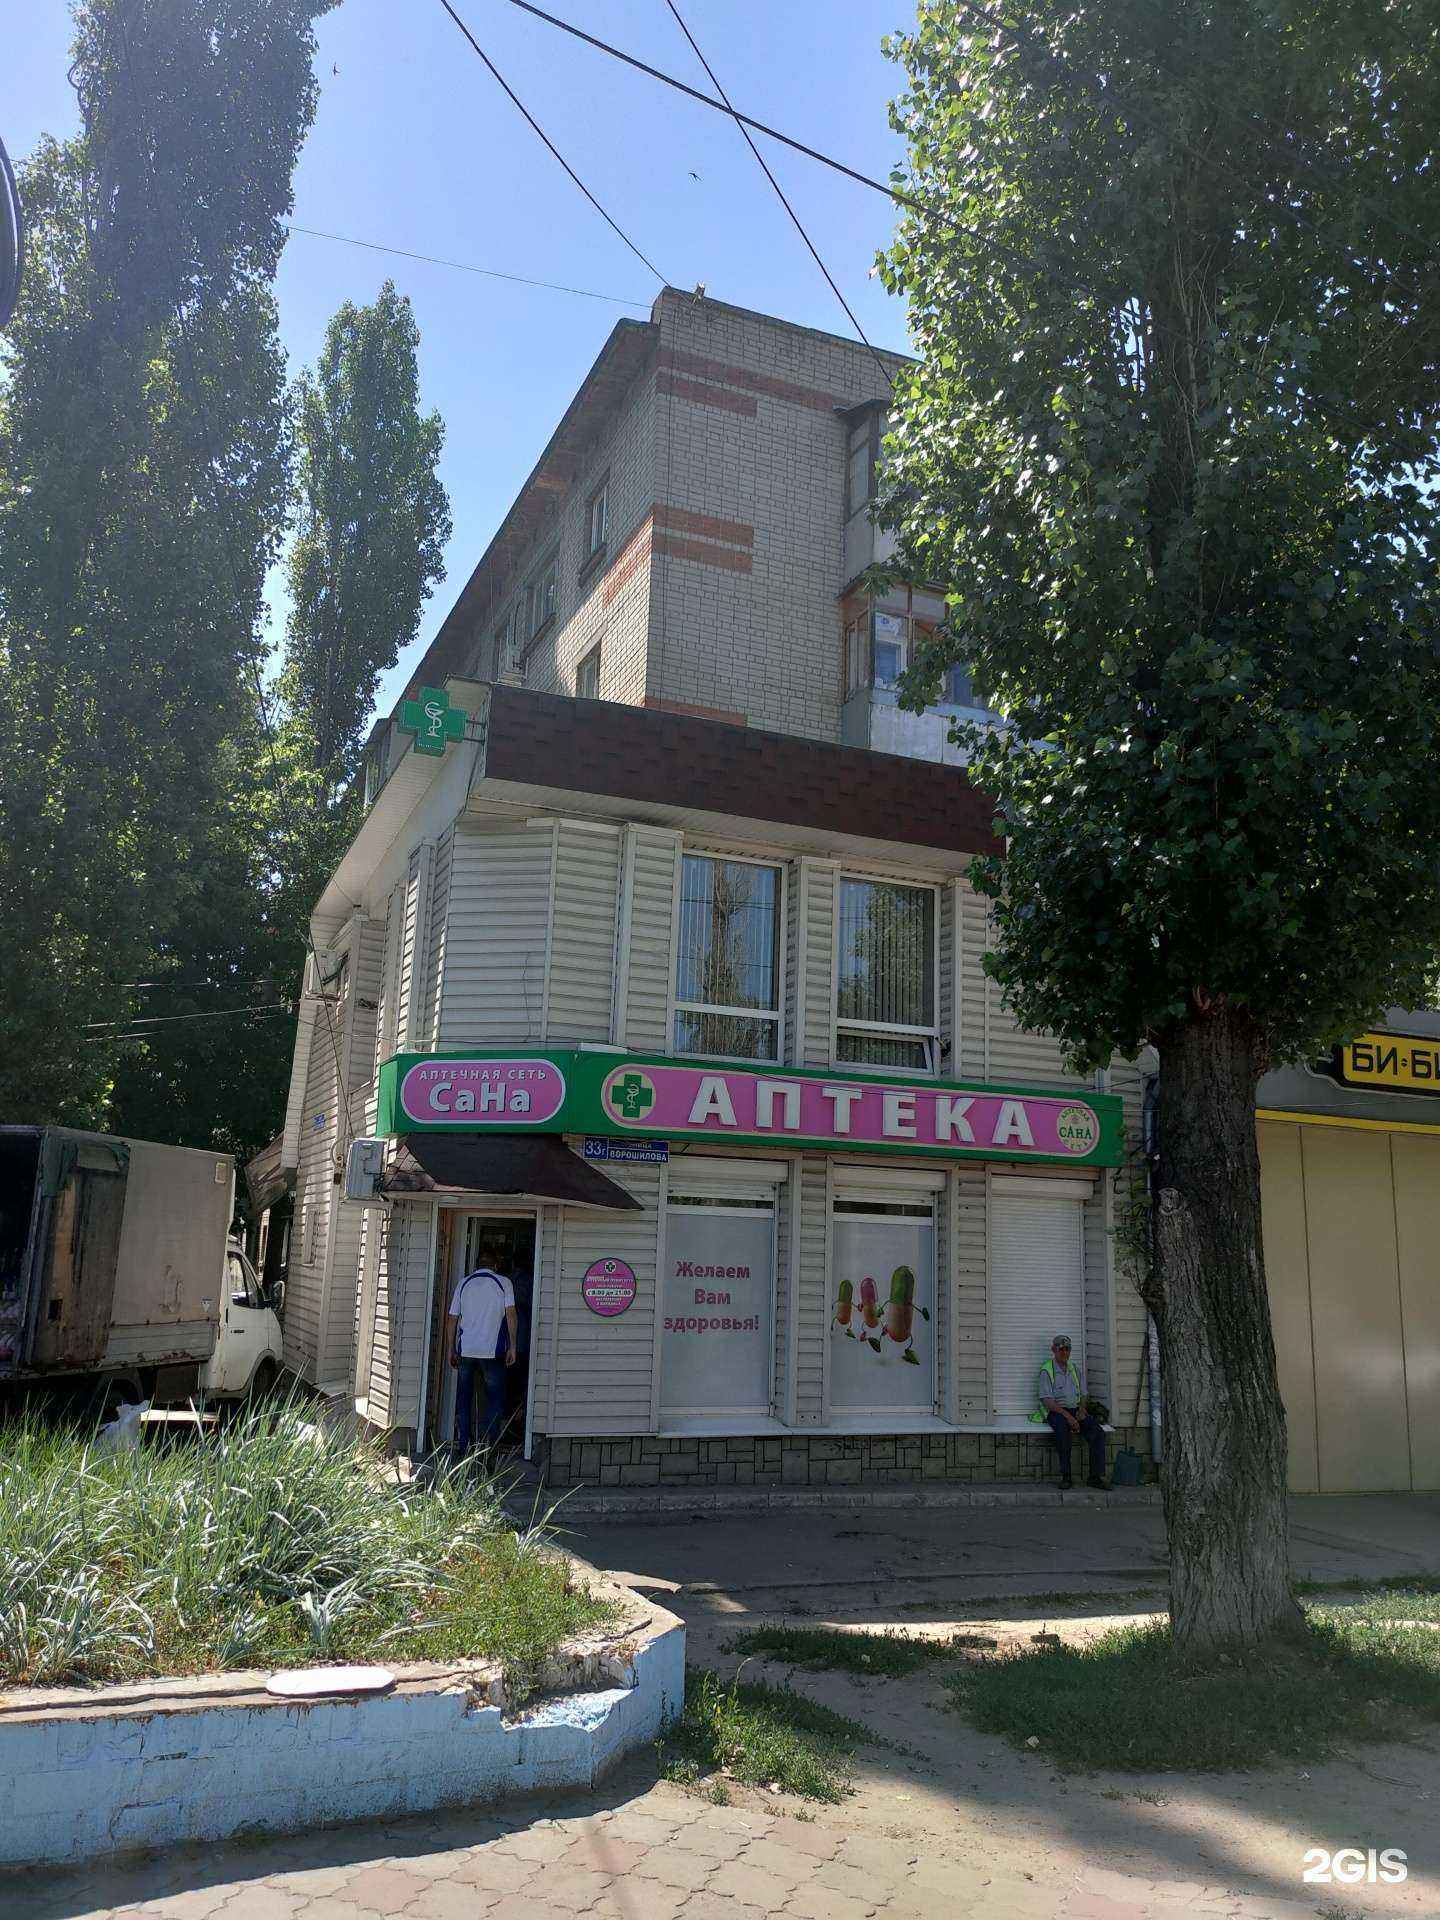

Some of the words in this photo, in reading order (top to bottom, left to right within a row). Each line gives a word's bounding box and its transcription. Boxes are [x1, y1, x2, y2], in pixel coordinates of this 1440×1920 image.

[419, 1069, 502, 1080] АПТЕЧНАЯ
[509, 1068, 546, 1080] СЕТЬ
[430, 1082, 531, 1113] СаНа
[688, 1077, 1035, 1146] АПТЕКА
[1059, 1125, 1092, 1139] САНА
[610, 1151, 667, 1162] ВОРОШИЛОВА
[676, 1261, 750, 1279] Желаем
[694, 1289, 731, 1305] Вам
[664, 1315, 759, 1333] здоровья!
